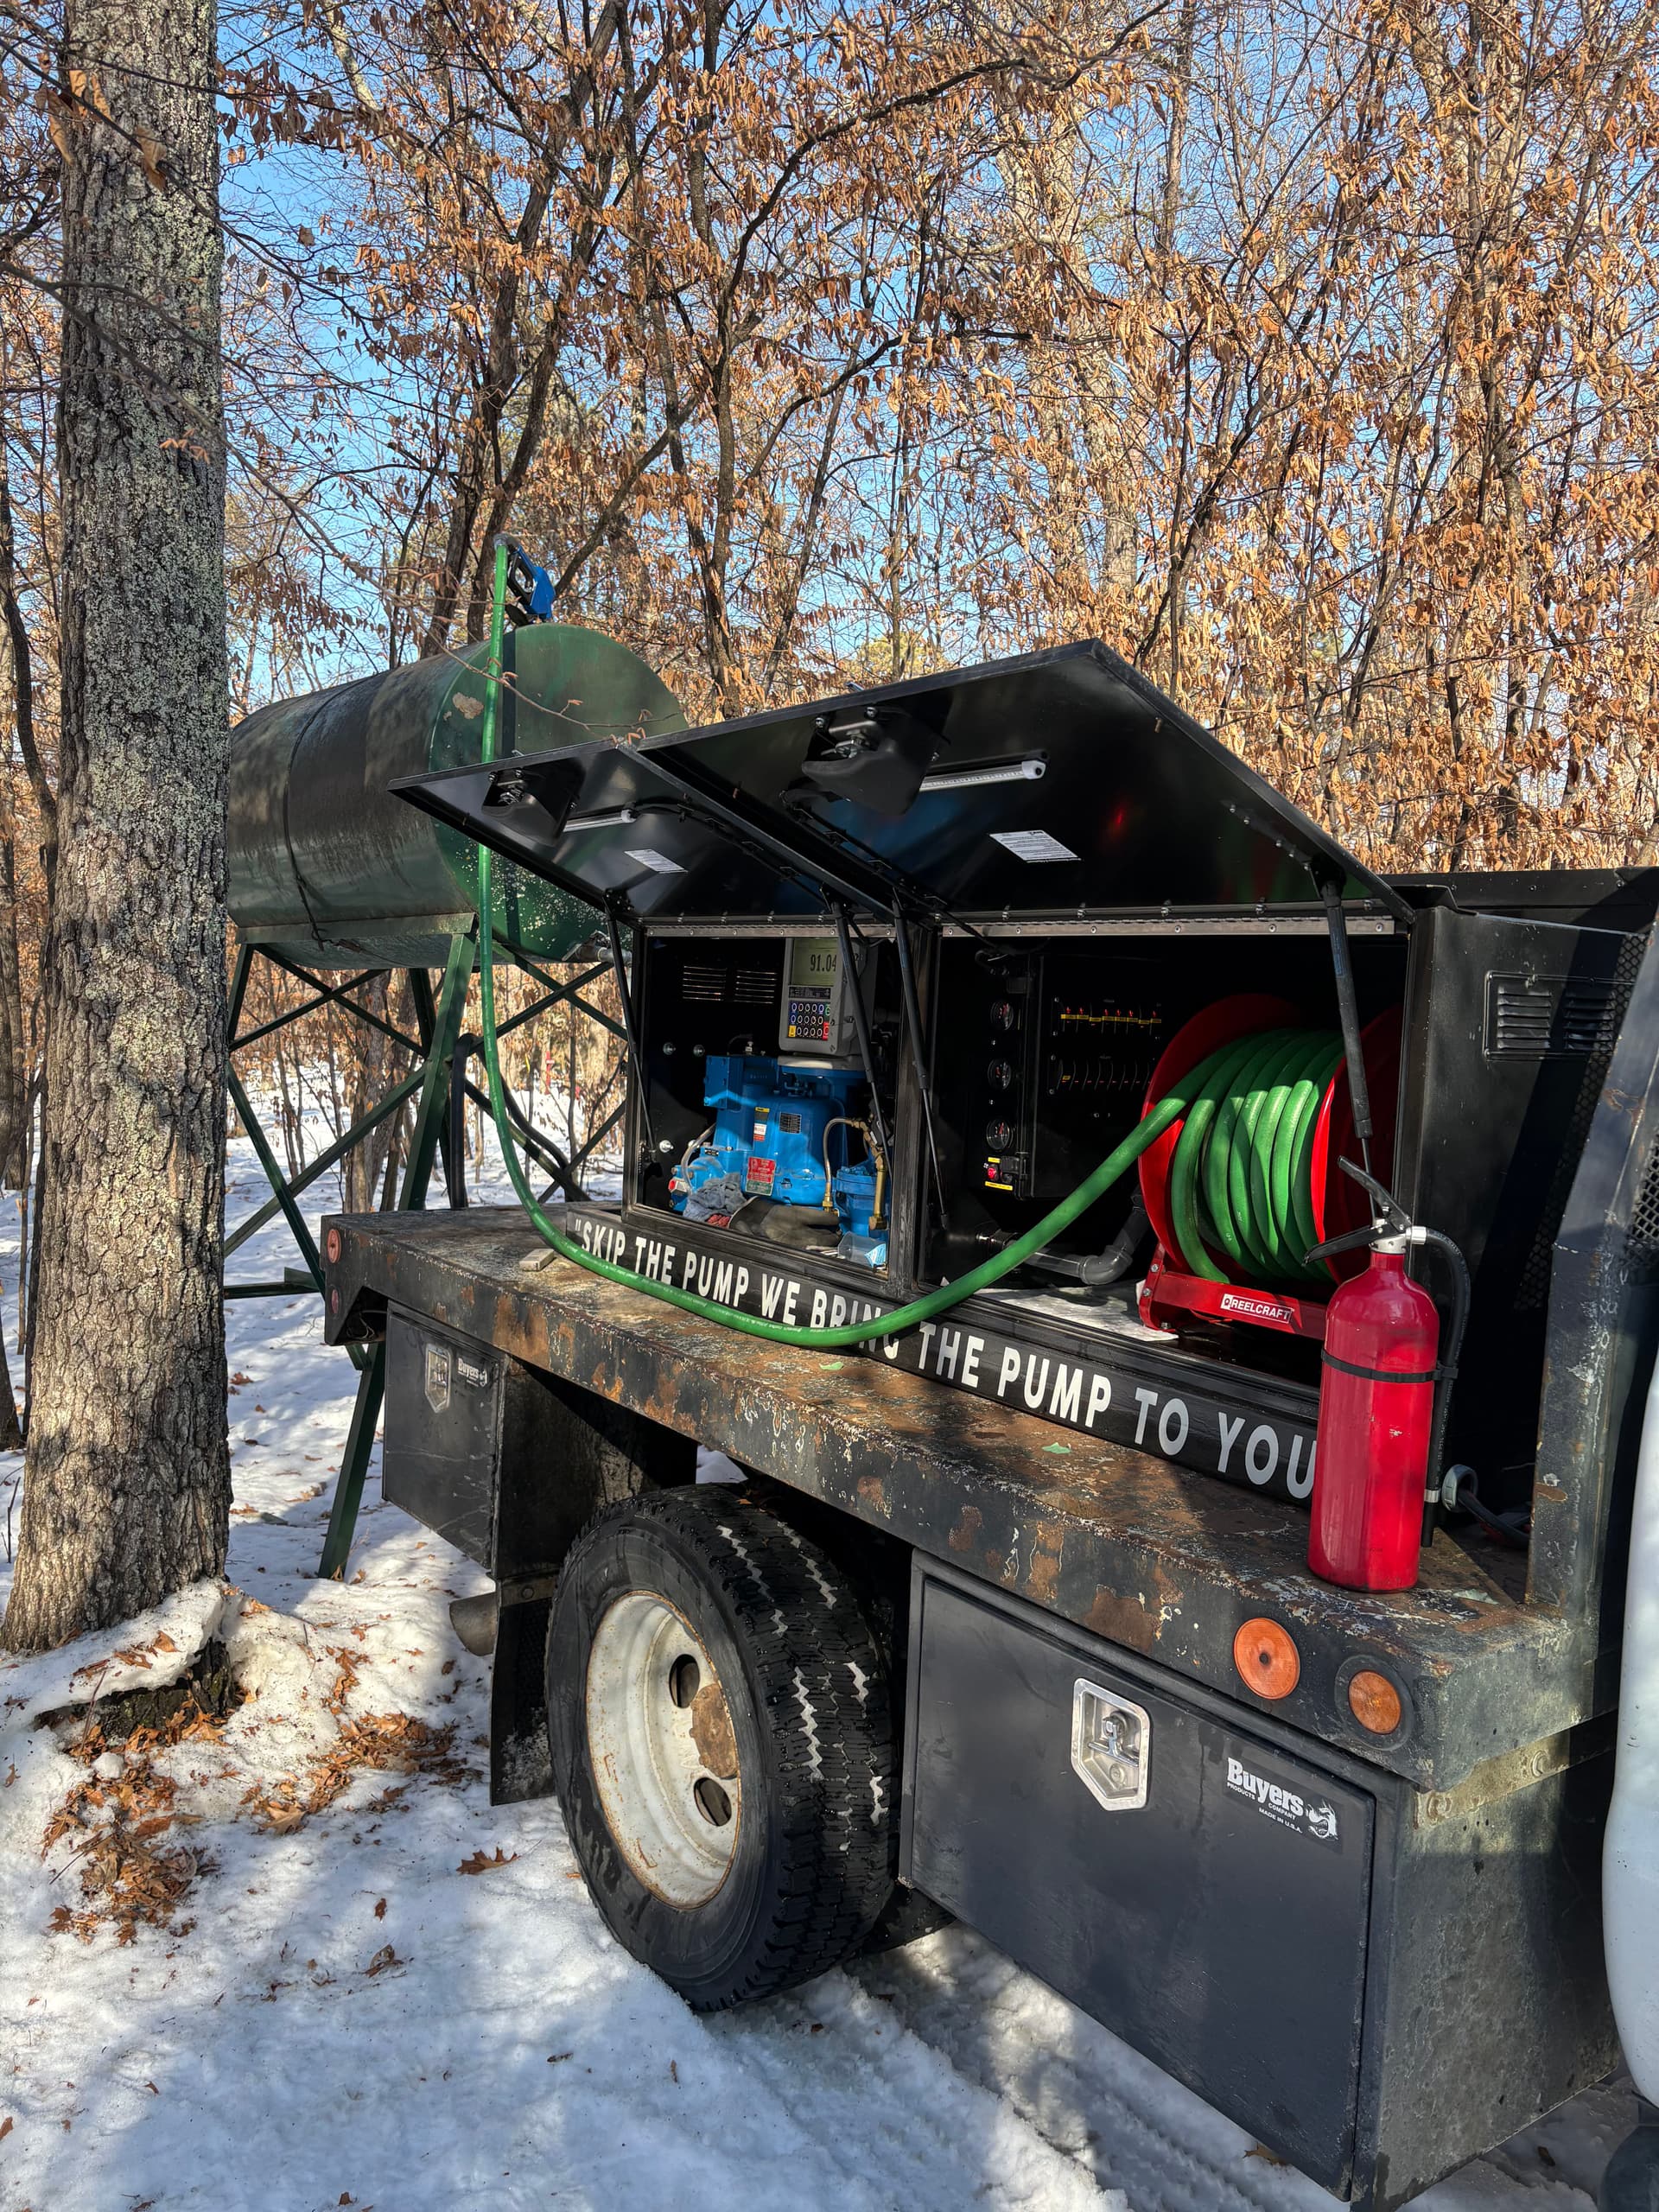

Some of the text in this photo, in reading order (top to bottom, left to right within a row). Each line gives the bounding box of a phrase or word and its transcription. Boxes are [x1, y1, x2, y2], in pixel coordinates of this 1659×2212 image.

[1230, 1299, 1290, 1320] REELCRAFT
[635, 1236, 677, 1285] THE
[683, 1251, 749, 1307] PUMP
[761, 1273, 801, 1325] WE
[918, 1320, 985, 1389] THE
[997, 1346, 1112, 1428] PUMP
[1135, 1387, 1190, 1456] TO
[1218, 1411, 1316, 1499] YOU
[1227, 1757, 1304, 1816] Buyers
[1227, 1782, 1296, 1821] PRODUCTS COMPANY
[1259, 1807, 1275, 1821] MADE
[1276, 1815, 1284, 1826] IN
